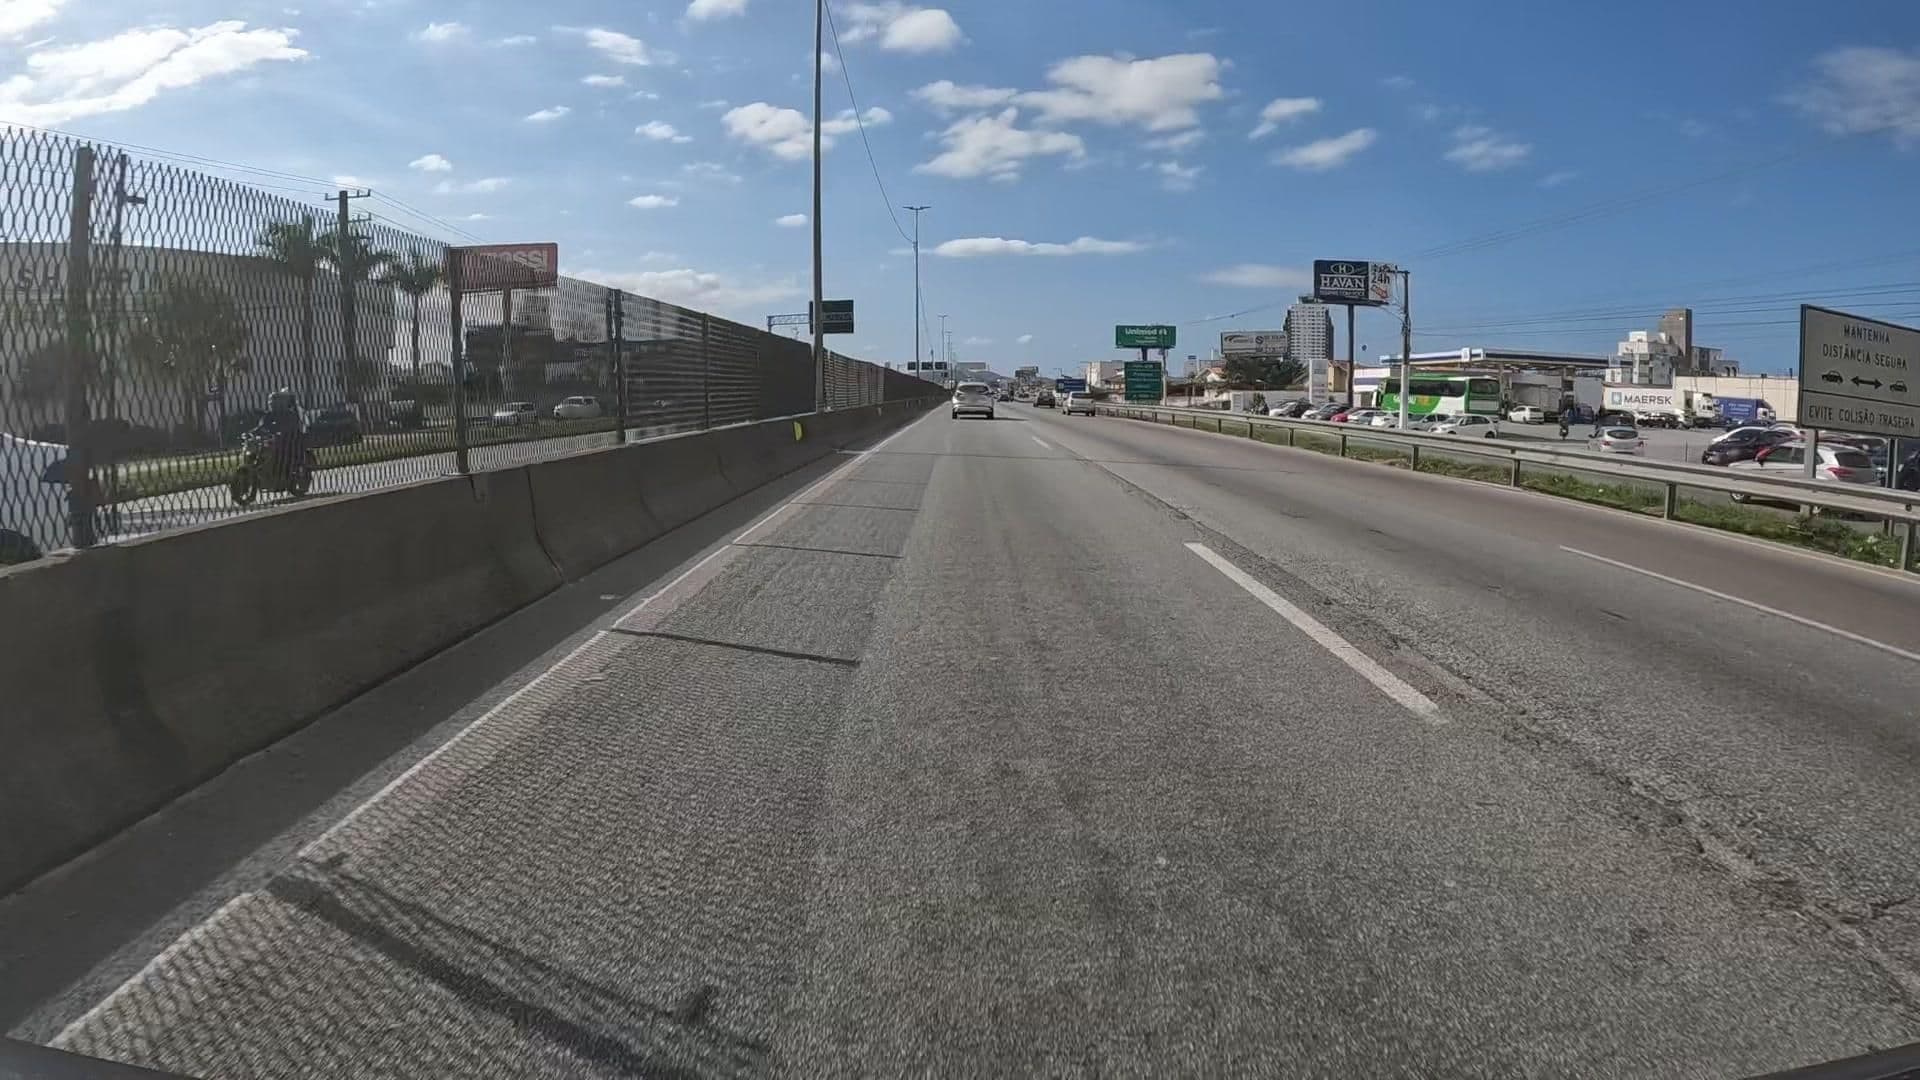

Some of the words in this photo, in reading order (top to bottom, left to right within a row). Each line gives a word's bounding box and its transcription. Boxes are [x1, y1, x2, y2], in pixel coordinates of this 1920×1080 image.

[1321, 276, 1366, 289] HAVAN
[1843, 324, 1891, 345] MANTENHA
[1822, 343, 1872, 364] DISTÂNCIA
[1874, 352, 1908, 371] SEGURA
[1623, 394, 1673, 406] MAERSK
[1808, 404, 1833, 421] EVITE
[1839, 407, 1875, 426] COLISÃO
[1879, 414, 1915, 428] TRASEIRA
